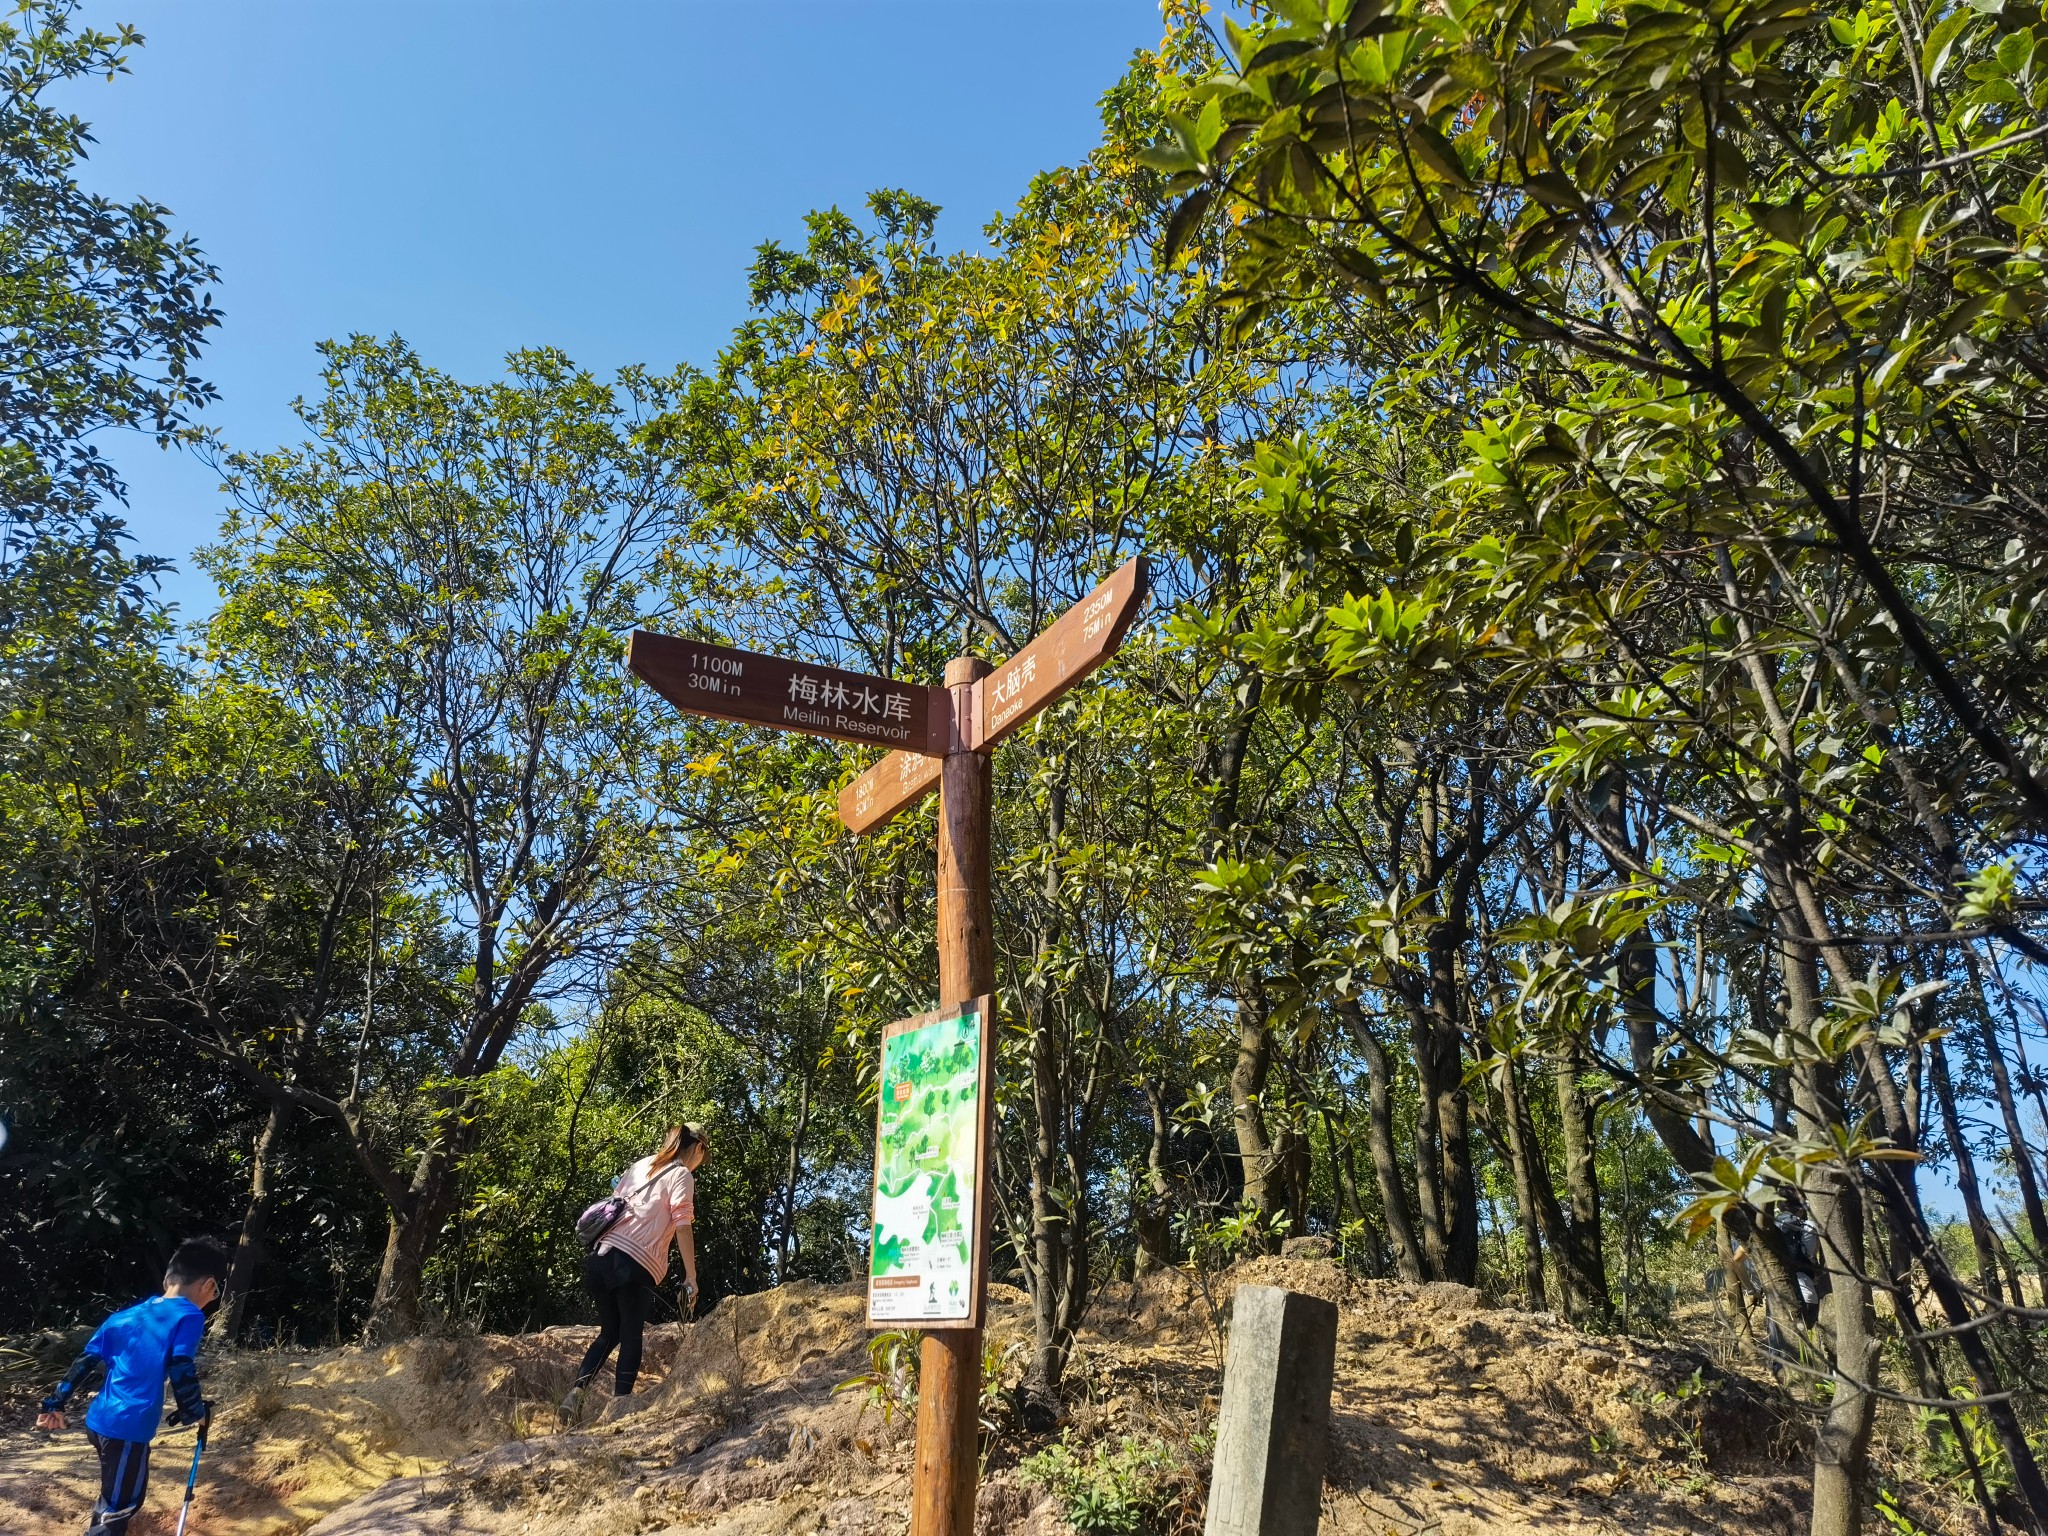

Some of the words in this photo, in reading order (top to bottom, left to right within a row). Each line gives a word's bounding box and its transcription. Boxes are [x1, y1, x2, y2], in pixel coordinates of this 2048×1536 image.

[1083, 588, 1113, 624] 2350M
[1083, 613, 1111, 643] 75Min
[691, 653, 743, 677] 1100M
[688, 673, 741, 697] 30Min
[788, 673, 912, 722] 梅林水库
[991, 654, 1036, 711] 大脑壳
[783, 705, 830, 727] Meilin
[835, 714, 910, 740] Reservoir
[991, 697, 1023, 730] Danaoke
